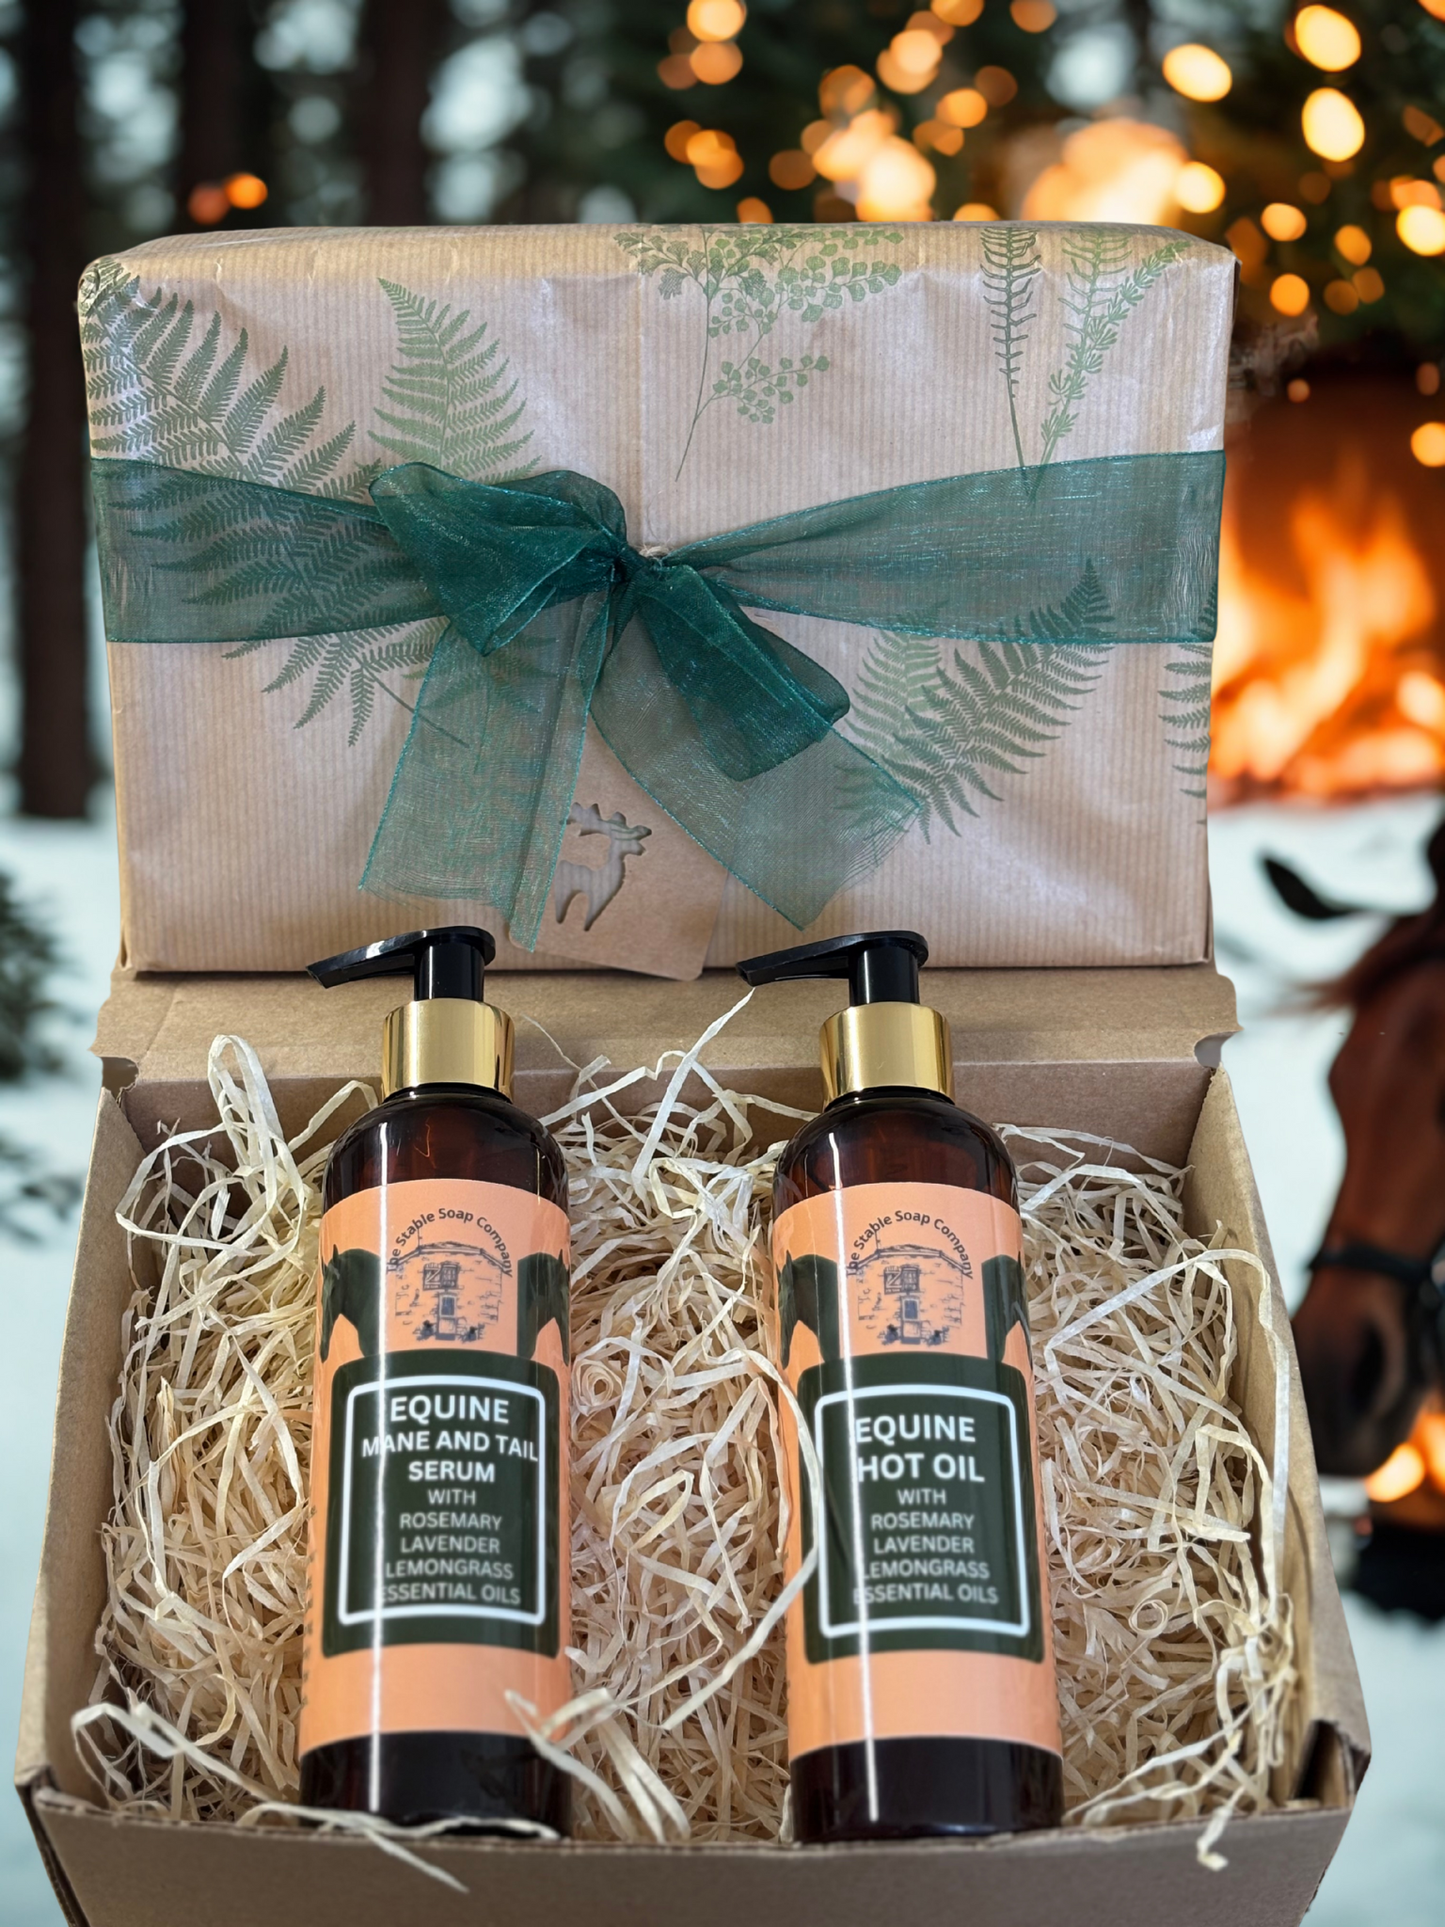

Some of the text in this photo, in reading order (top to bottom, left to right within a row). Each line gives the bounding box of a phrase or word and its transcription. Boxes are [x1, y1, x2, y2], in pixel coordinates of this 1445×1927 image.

[396, 1212, 435, 1247] Stable
[438, 1208, 474, 1224] Soap
[476, 1216, 513, 1278] Company
[853, 1215, 893, 1250] Stable
[894, 1210, 930, 1226] Soap
[933, 1218, 973, 1280] Company
[390, 1394, 510, 1425] EQUINE
[855, 1414, 976, 1447] EQUINE
[362, 1430, 539, 1462] MANE AND TAIL
[408, 1460, 496, 1483] SERUM
[857, 1452, 985, 1483] HOT OIL
[427, 1488, 476, 1506] WITH
[896, 1488, 947, 1506] WITH
[399, 1511, 502, 1532] ROSEMARY
[870, 1511, 975, 1532] ROSEMARY
[401, 1535, 500, 1554] LAVENDER
[873, 1535, 974, 1555] LAVENDER
[385, 1558, 514, 1580] LEMONGRASS
[480, 1584, 521, 1605] OILS
[853, 1582, 998, 1605] ESSENTIAL OILS
